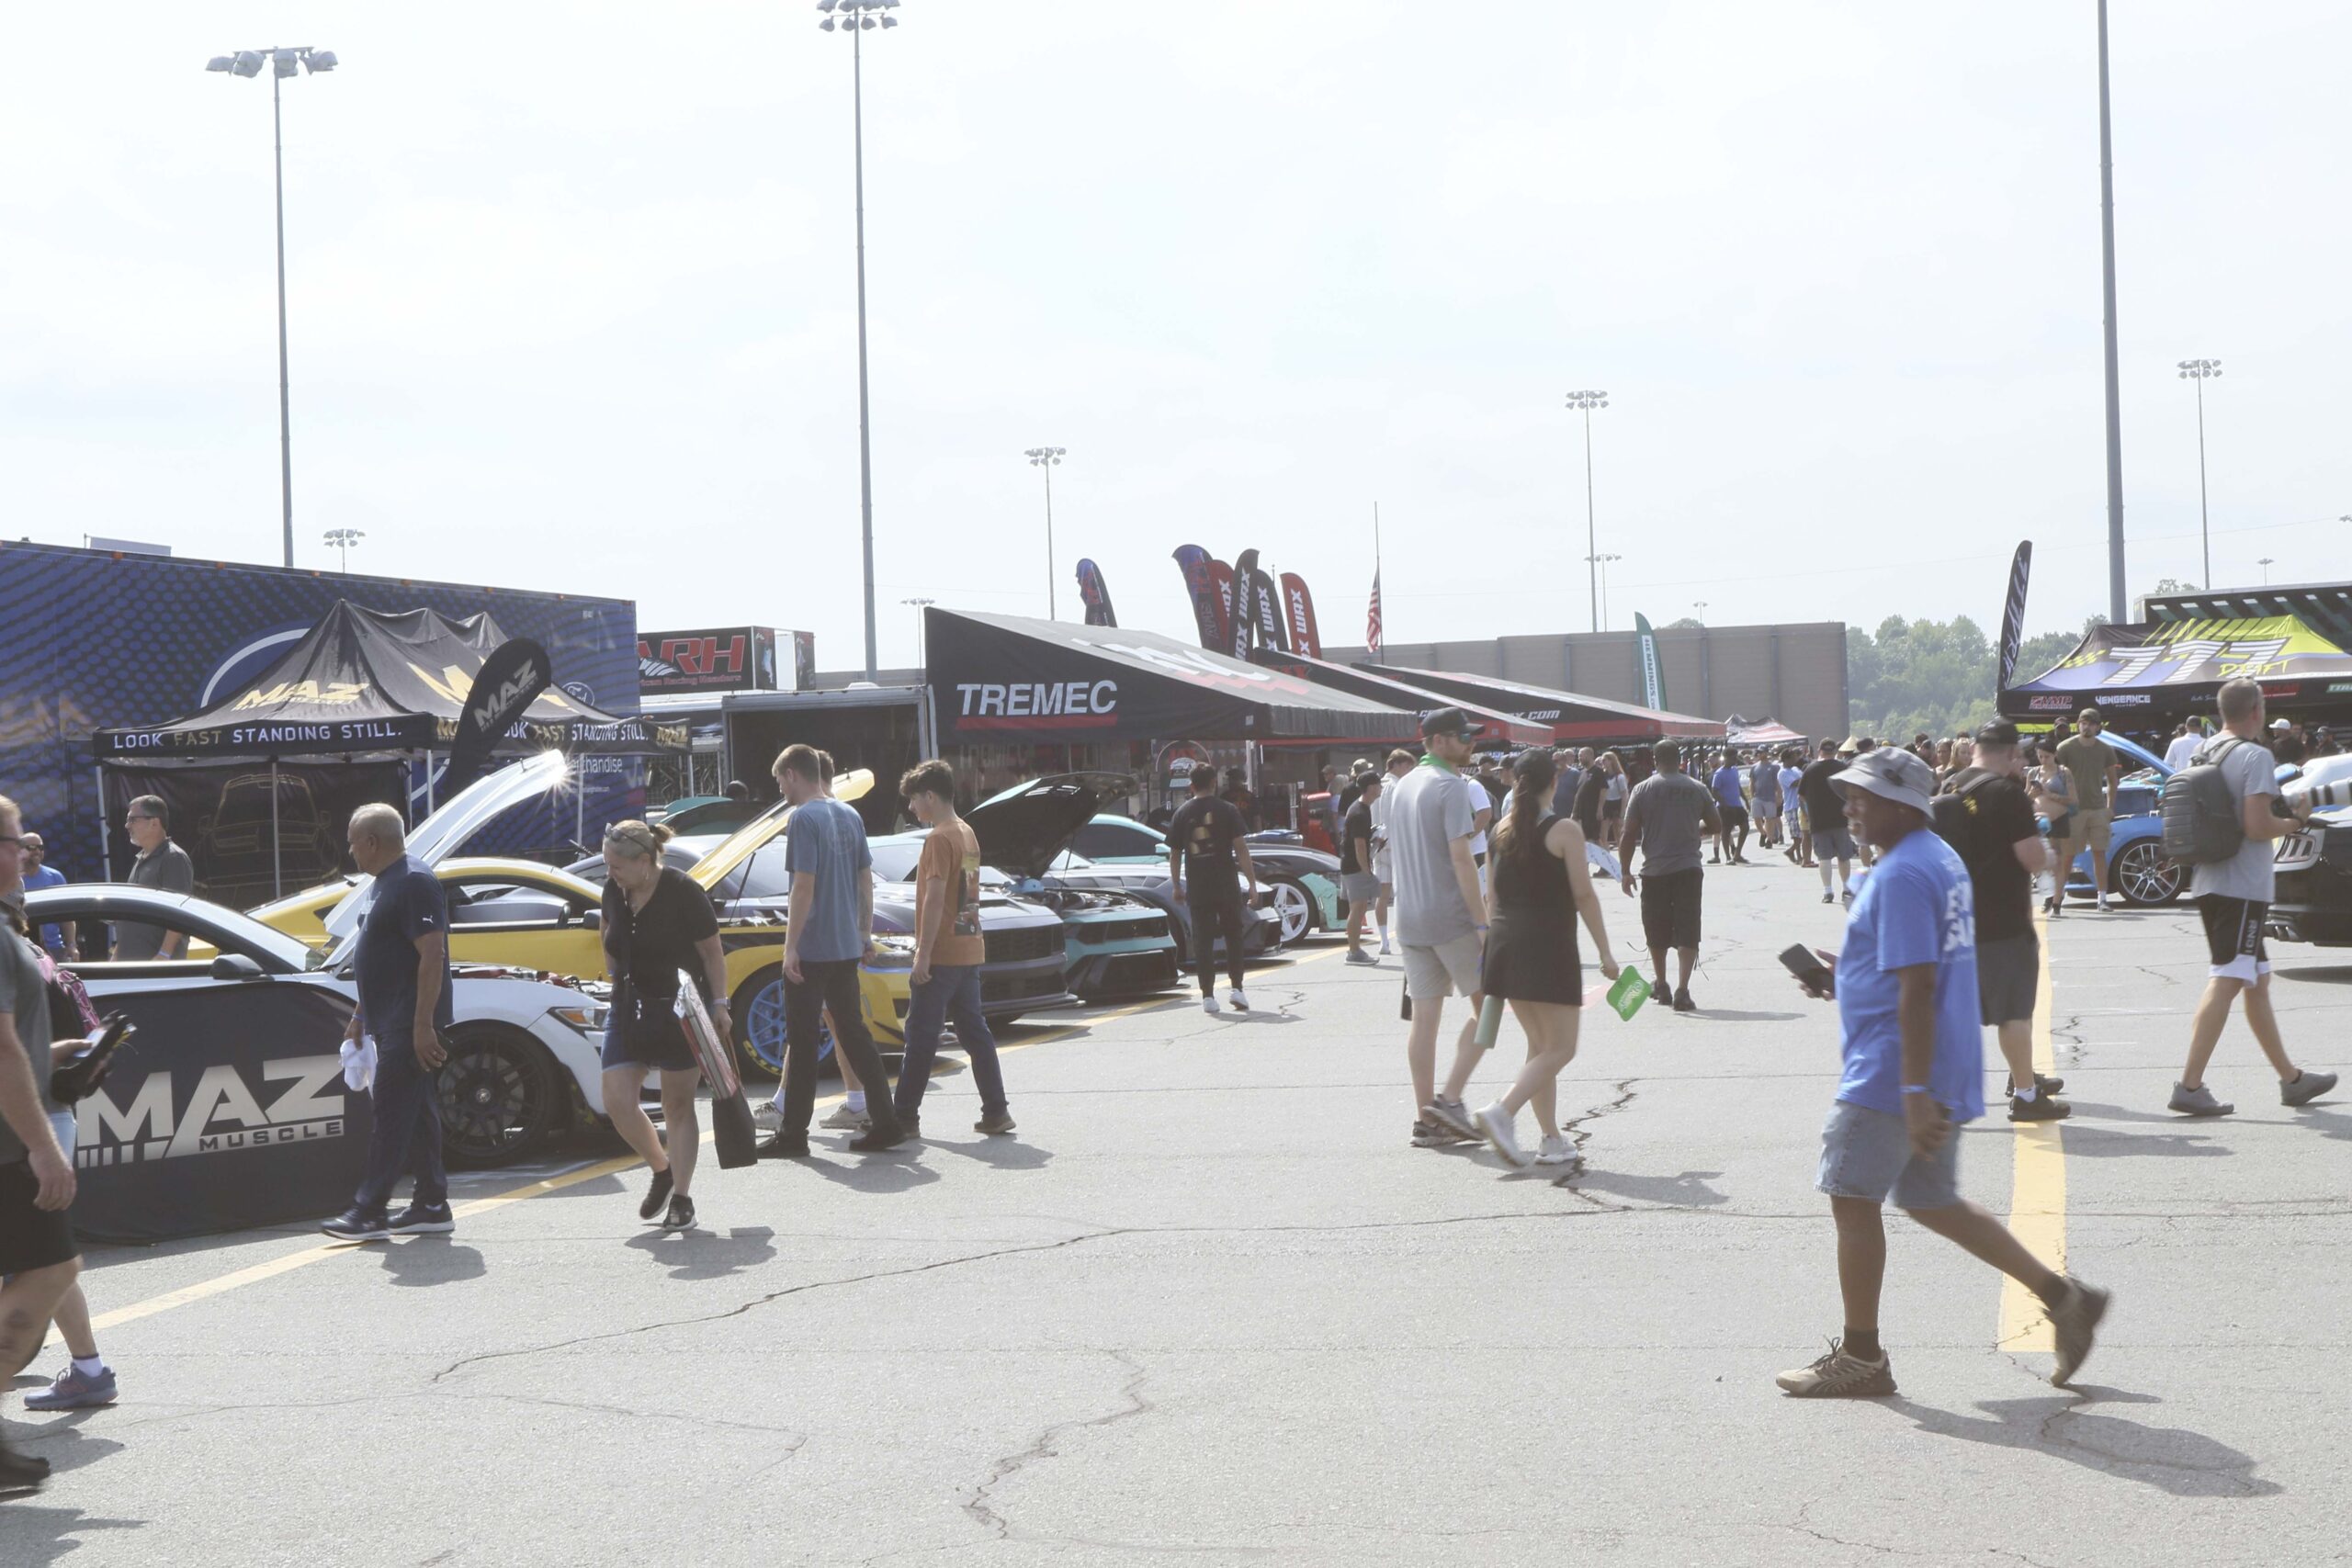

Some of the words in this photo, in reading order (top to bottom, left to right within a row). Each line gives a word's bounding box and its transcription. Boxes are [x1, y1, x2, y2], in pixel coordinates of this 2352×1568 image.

[1238, 567, 1250, 620] WAX
[1257, 585, 1274, 632] WAX
[1290, 588, 1306, 634] WAX
[474, 658, 537, 733] MAZ
[956, 680, 1118, 716] TREMEC
[2096, 694, 2151, 705] VENGEANCE
[114, 733, 163, 749] LOOK
[174, 730, 221, 747] FAST
[232, 726, 331, 744] STANDING
[341, 722, 402, 739] STILL.
[504, 721, 529, 739] OK
[533, 724, 566, 741] FAST
[571, 723, 619, 741] STANDING
[620, 723, 650, 741] STILL.
[75, 1053, 345, 1160] MAZ
[198, 1121, 342, 1152] MUSCLE
